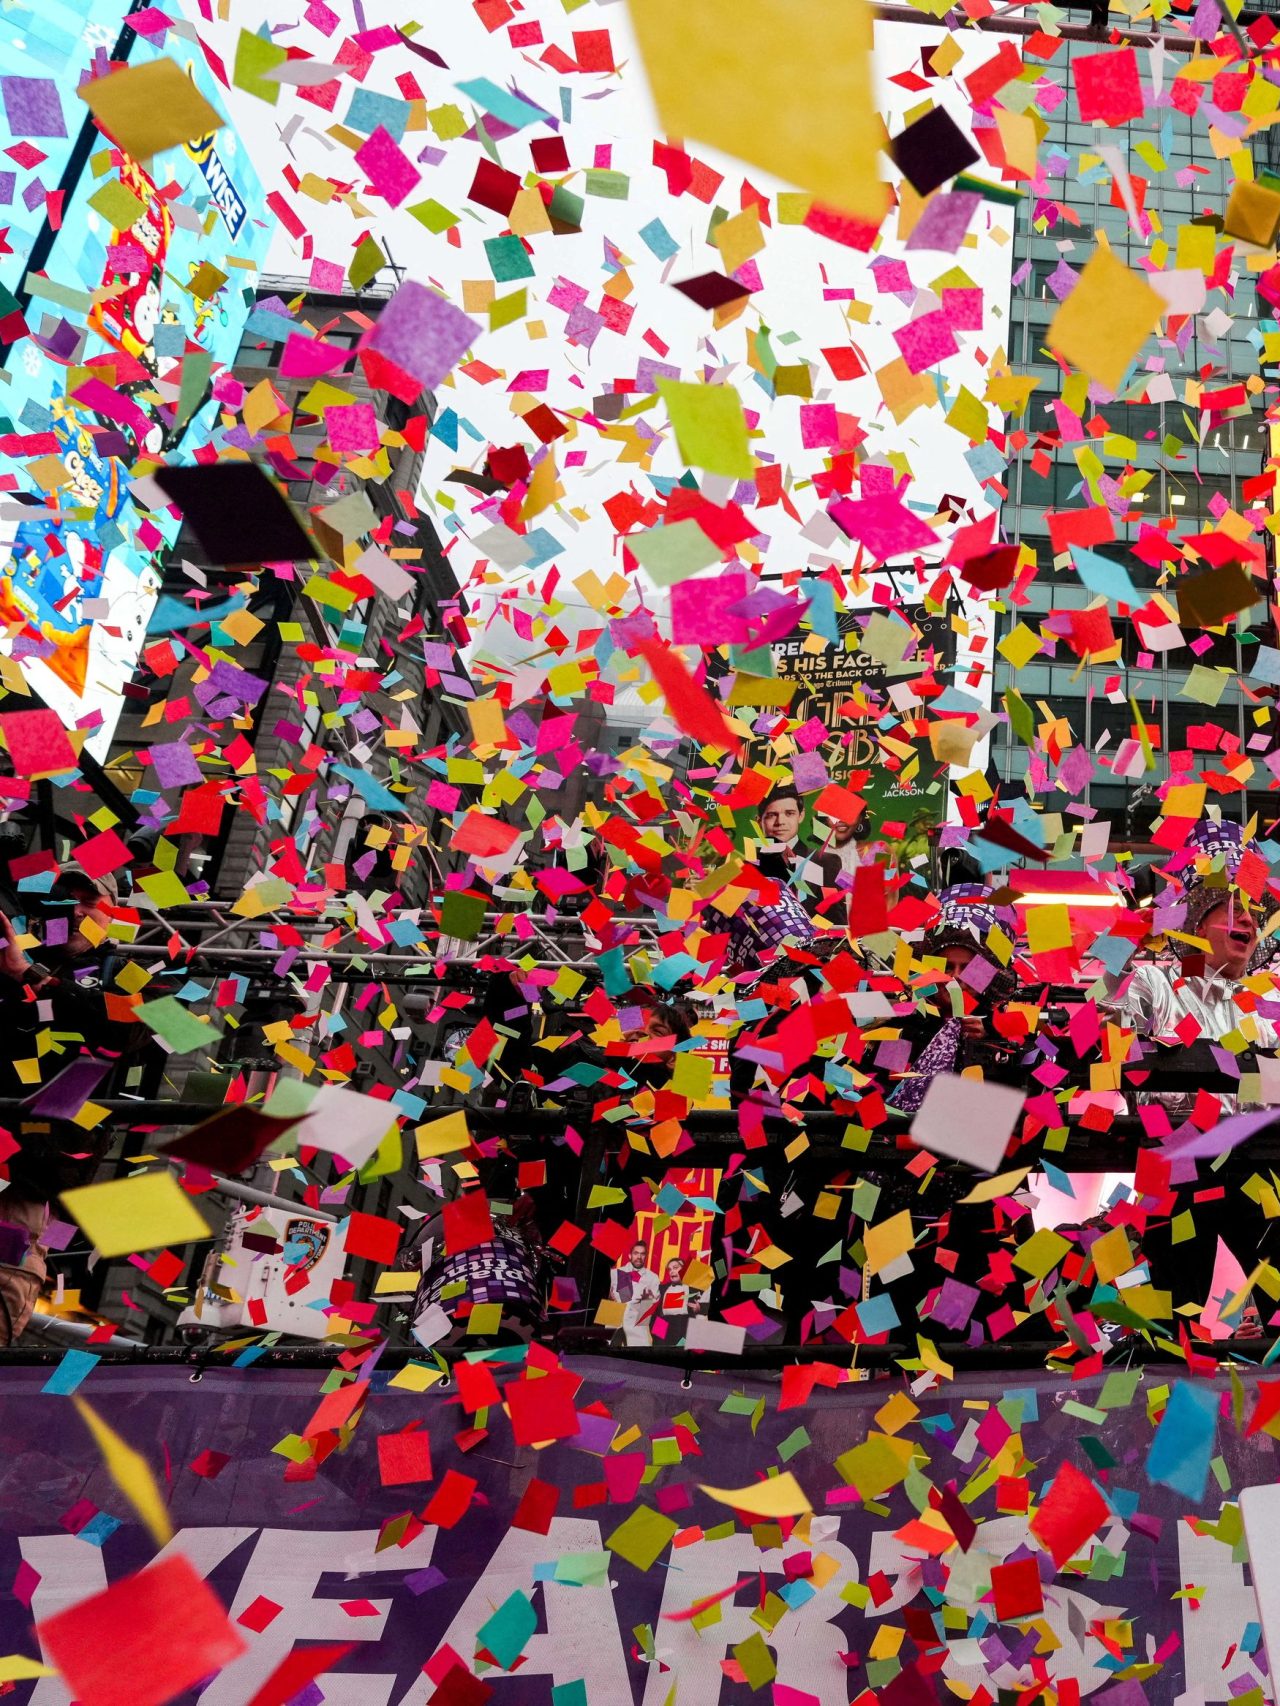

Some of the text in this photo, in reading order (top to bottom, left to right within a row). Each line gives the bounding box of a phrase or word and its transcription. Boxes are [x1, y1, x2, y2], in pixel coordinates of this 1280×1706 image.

[206, 150, 243, 234] WISE
[794, 656, 827, 672] HIS
[815, 670, 834, 680] THE
[837, 669, 863, 679] BACK
[865, 667, 879, 677] OF
[826, 679, 853, 688] Tribune
[882, 788, 924, 798] JACKSON
